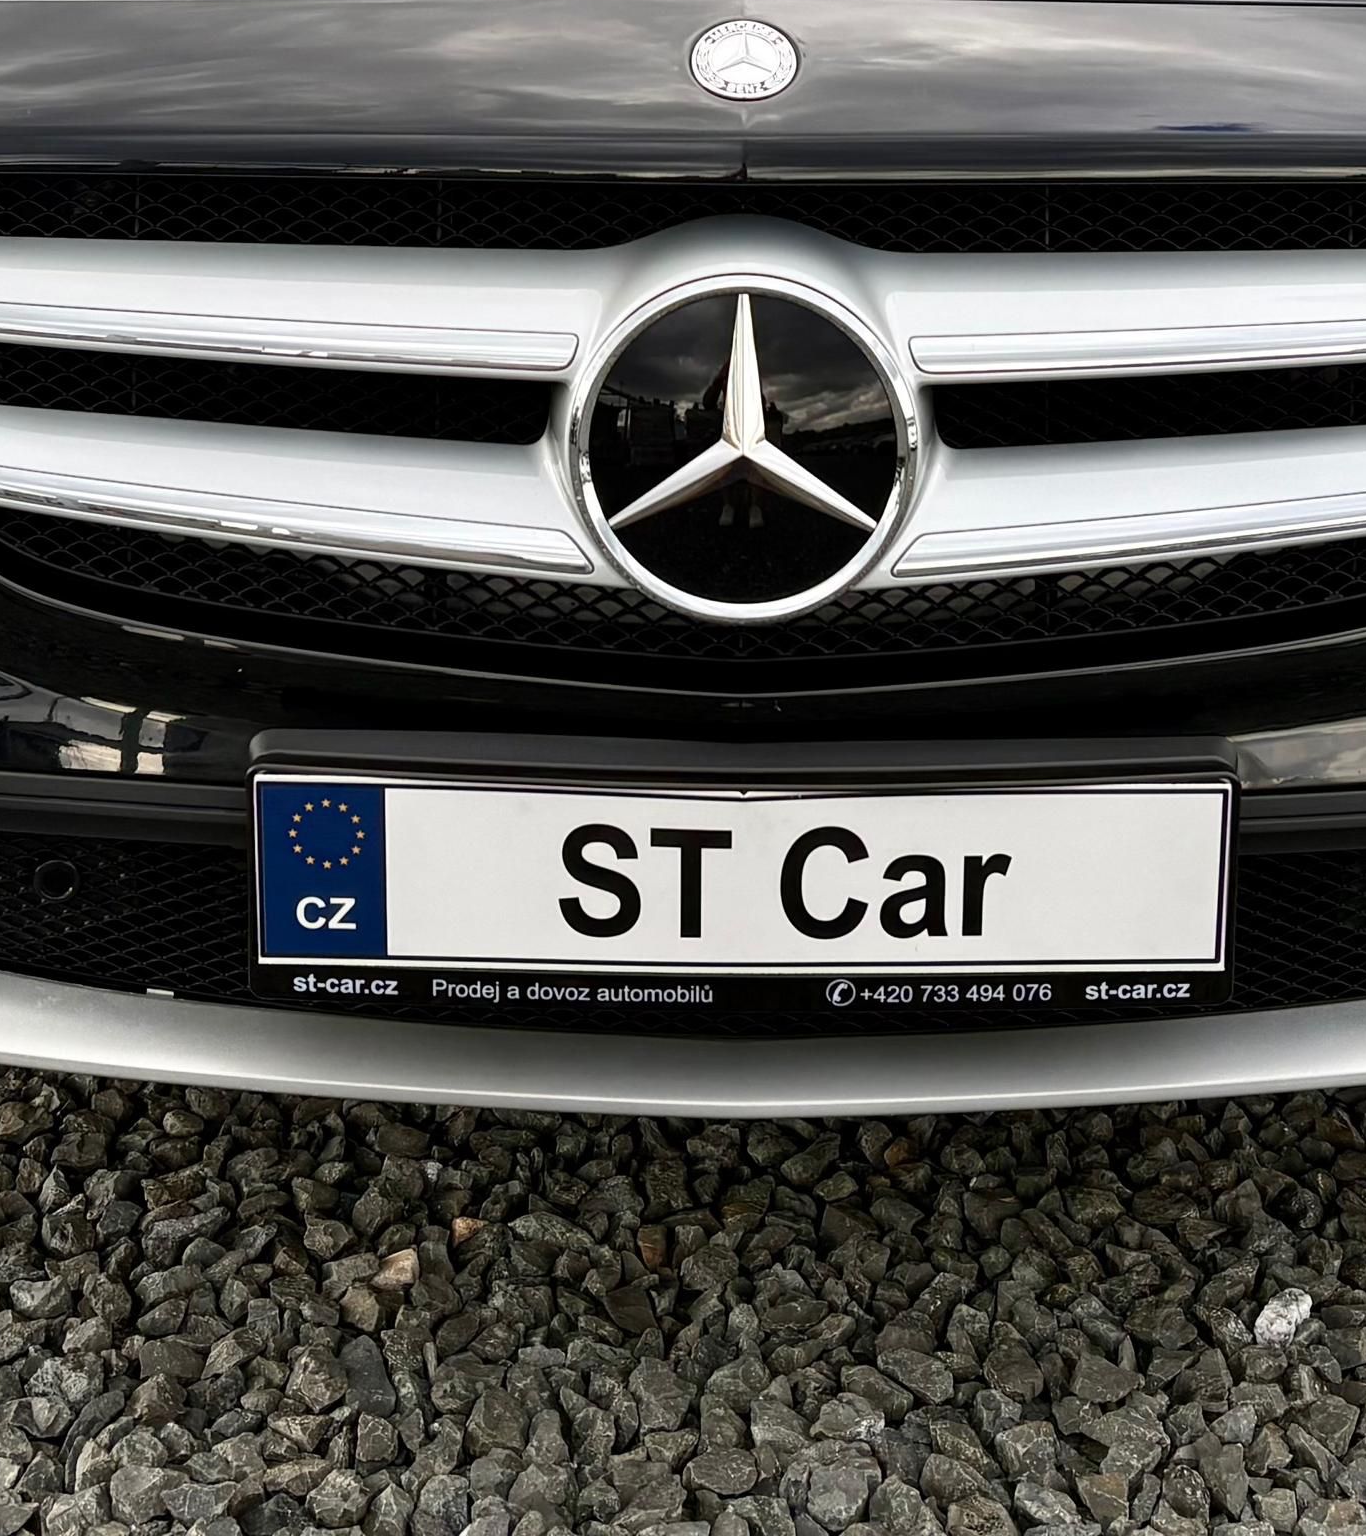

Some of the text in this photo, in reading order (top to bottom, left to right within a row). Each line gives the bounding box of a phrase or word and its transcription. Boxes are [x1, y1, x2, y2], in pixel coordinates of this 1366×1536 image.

[557, 822, 1013, 940] ST Car
[296, 896, 357, 930] CZ
[293, 973, 713, 1003] st-car.cz Prodej a dovoz automobilů
[859, 983, 1052, 1003] +420 733 494 076
[1085, 981, 1191, 1001] st-car.cz
